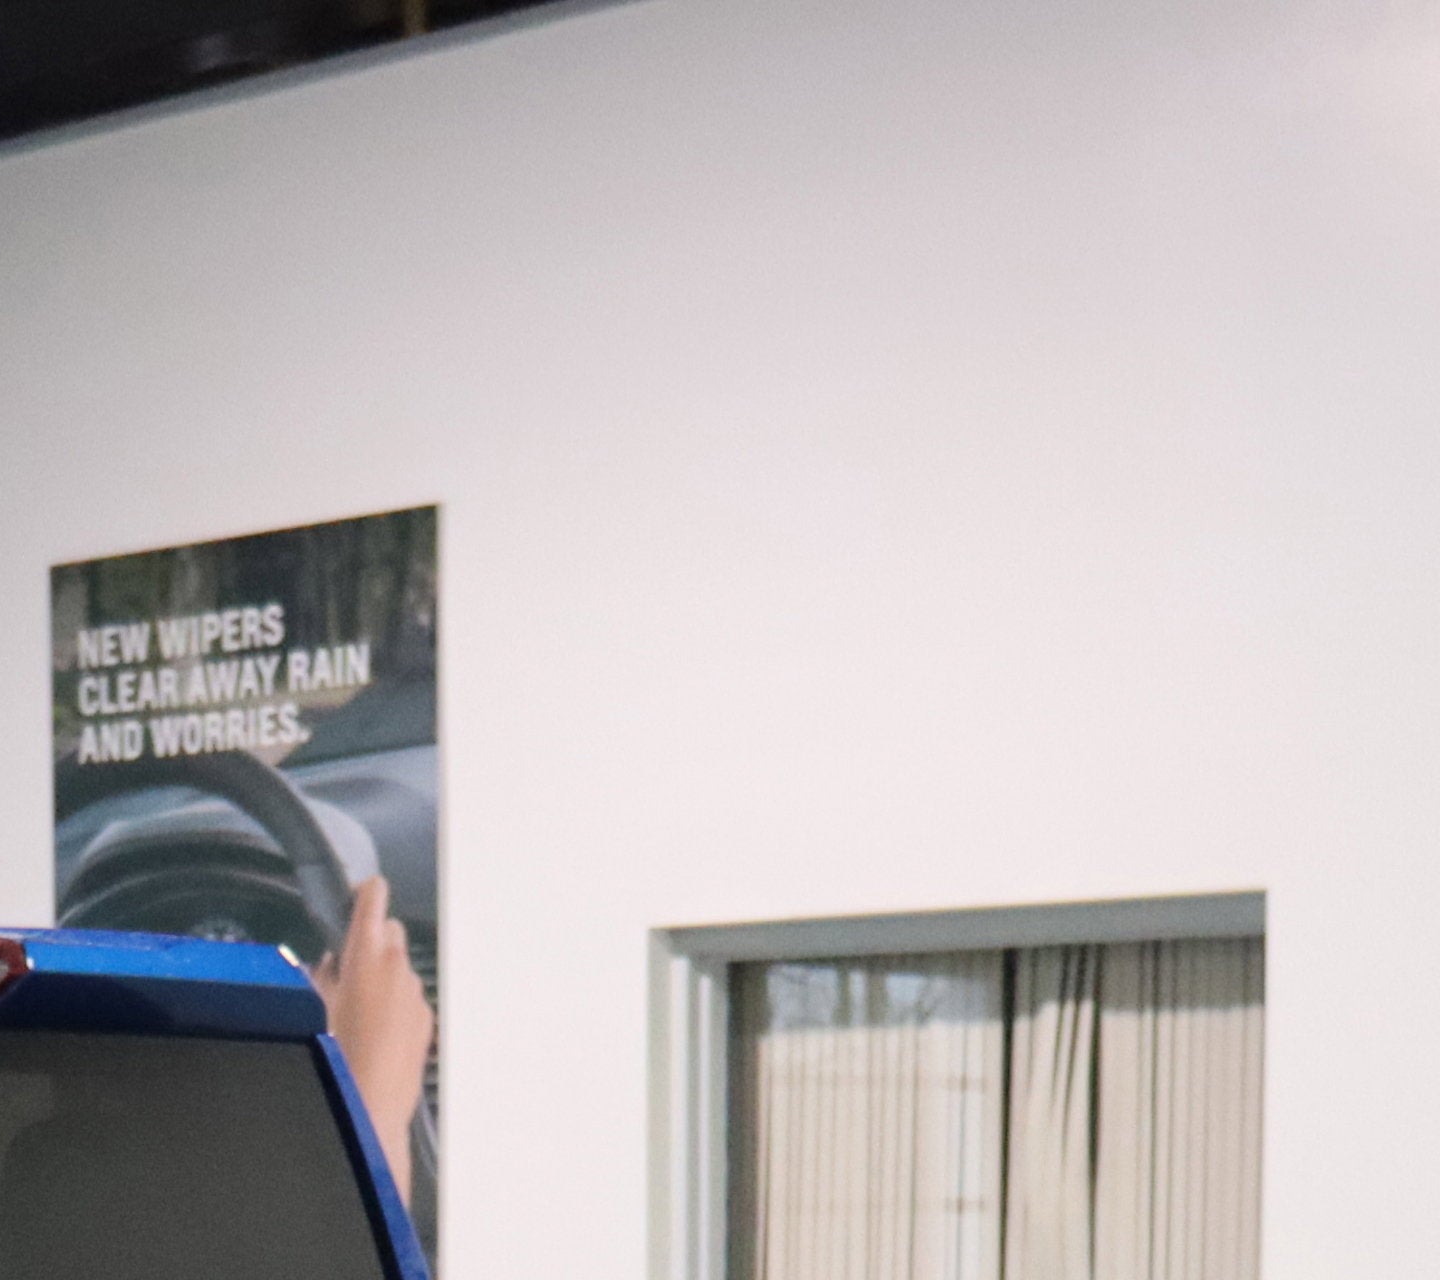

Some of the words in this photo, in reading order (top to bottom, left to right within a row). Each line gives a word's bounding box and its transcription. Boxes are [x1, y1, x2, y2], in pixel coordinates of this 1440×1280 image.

[78, 621, 151, 669] NEW
[156, 603, 286, 660] WIPERS
[78, 667, 185, 717] CLEAR
[188, 655, 281, 706] AWAY
[287, 642, 370, 693] RAIN
[78, 719, 144, 766] AND
[150, 702, 311, 759] WORRIES.
